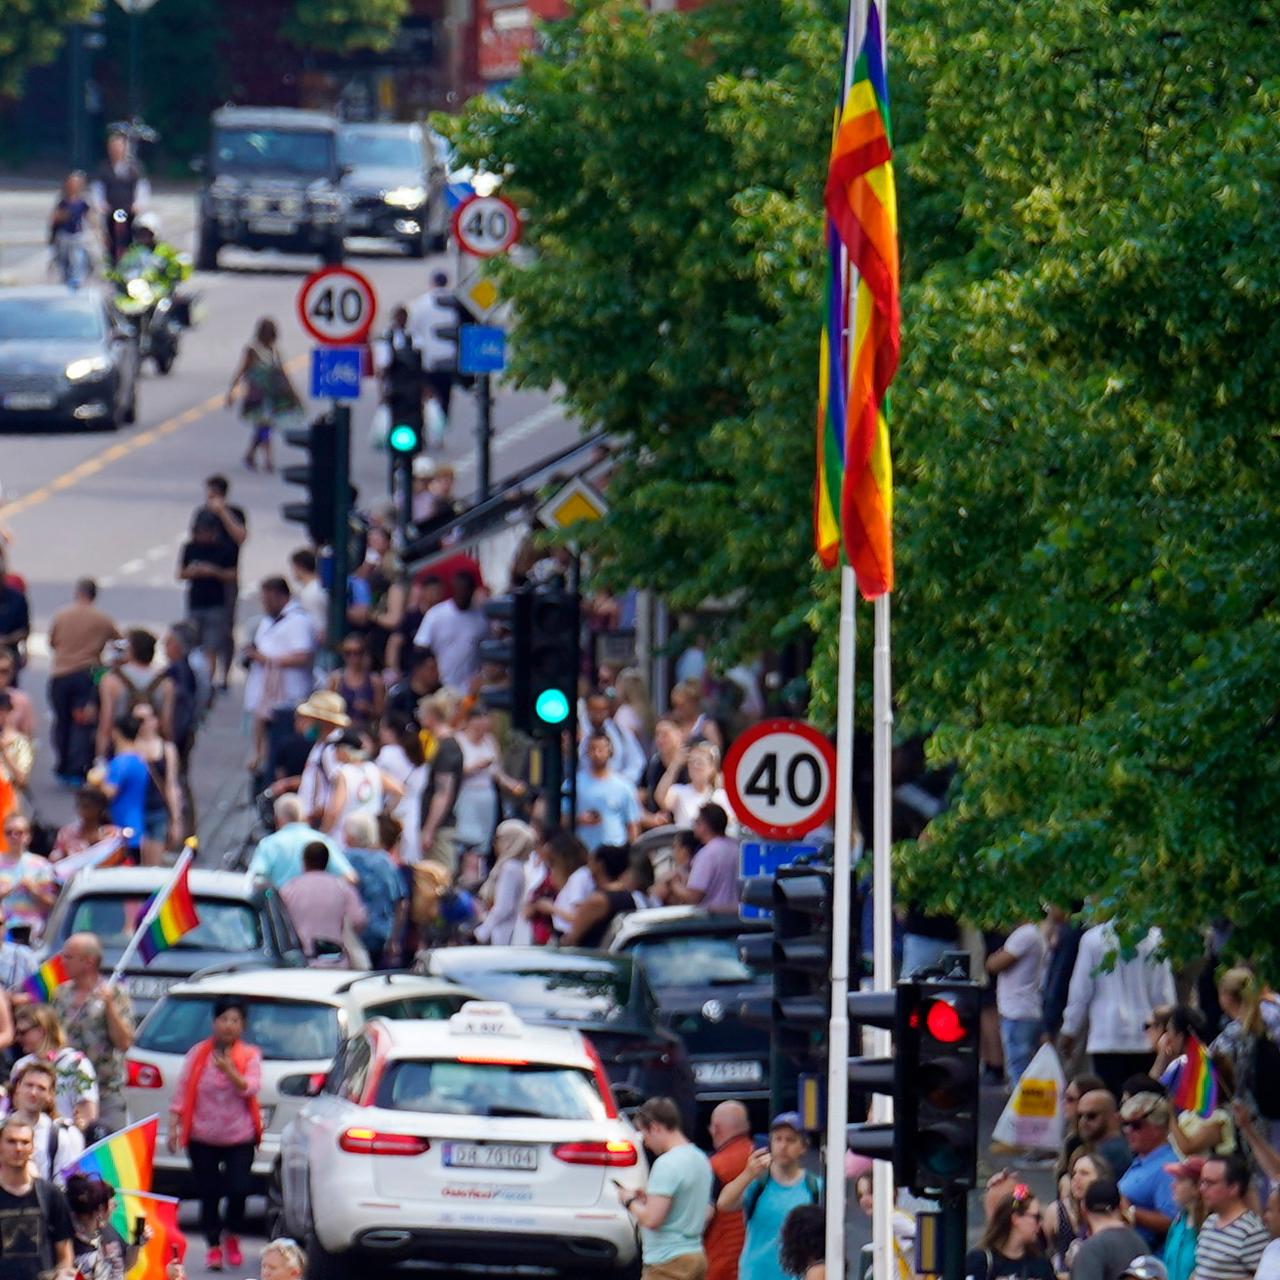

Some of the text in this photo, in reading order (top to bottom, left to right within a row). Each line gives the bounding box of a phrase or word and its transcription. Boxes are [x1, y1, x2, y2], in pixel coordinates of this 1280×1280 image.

[464, 209, 507, 241] 40
[312, 287, 363, 324] 40
[744, 752, 822, 808] 40
